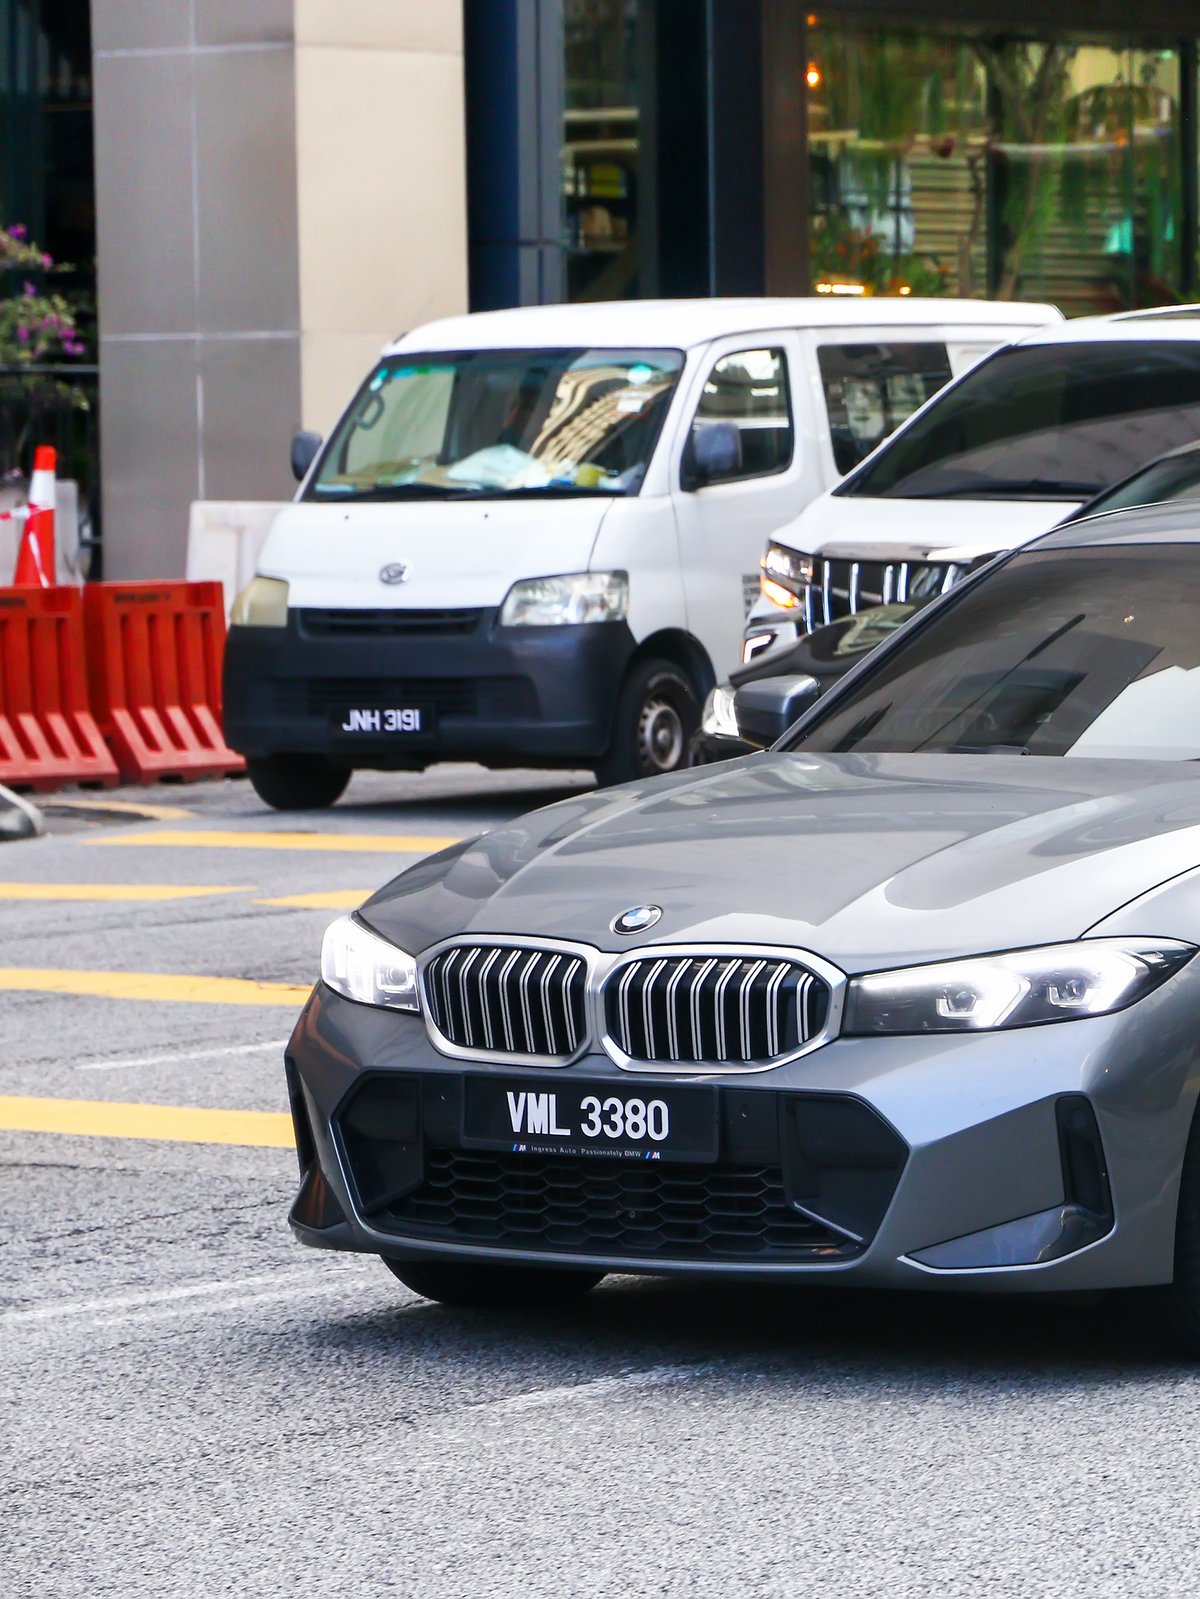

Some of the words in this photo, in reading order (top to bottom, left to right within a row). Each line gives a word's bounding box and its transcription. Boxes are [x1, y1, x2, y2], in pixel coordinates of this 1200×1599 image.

[341, 708, 380, 732] JNH
[383, 708, 420, 732] 3191
[506, 1091, 571, 1136] VML
[580, 1096, 669, 1141] 3380
[531, 1145, 557, 1154] Ingress
[581, 1148, 623, 1158] Passionately
